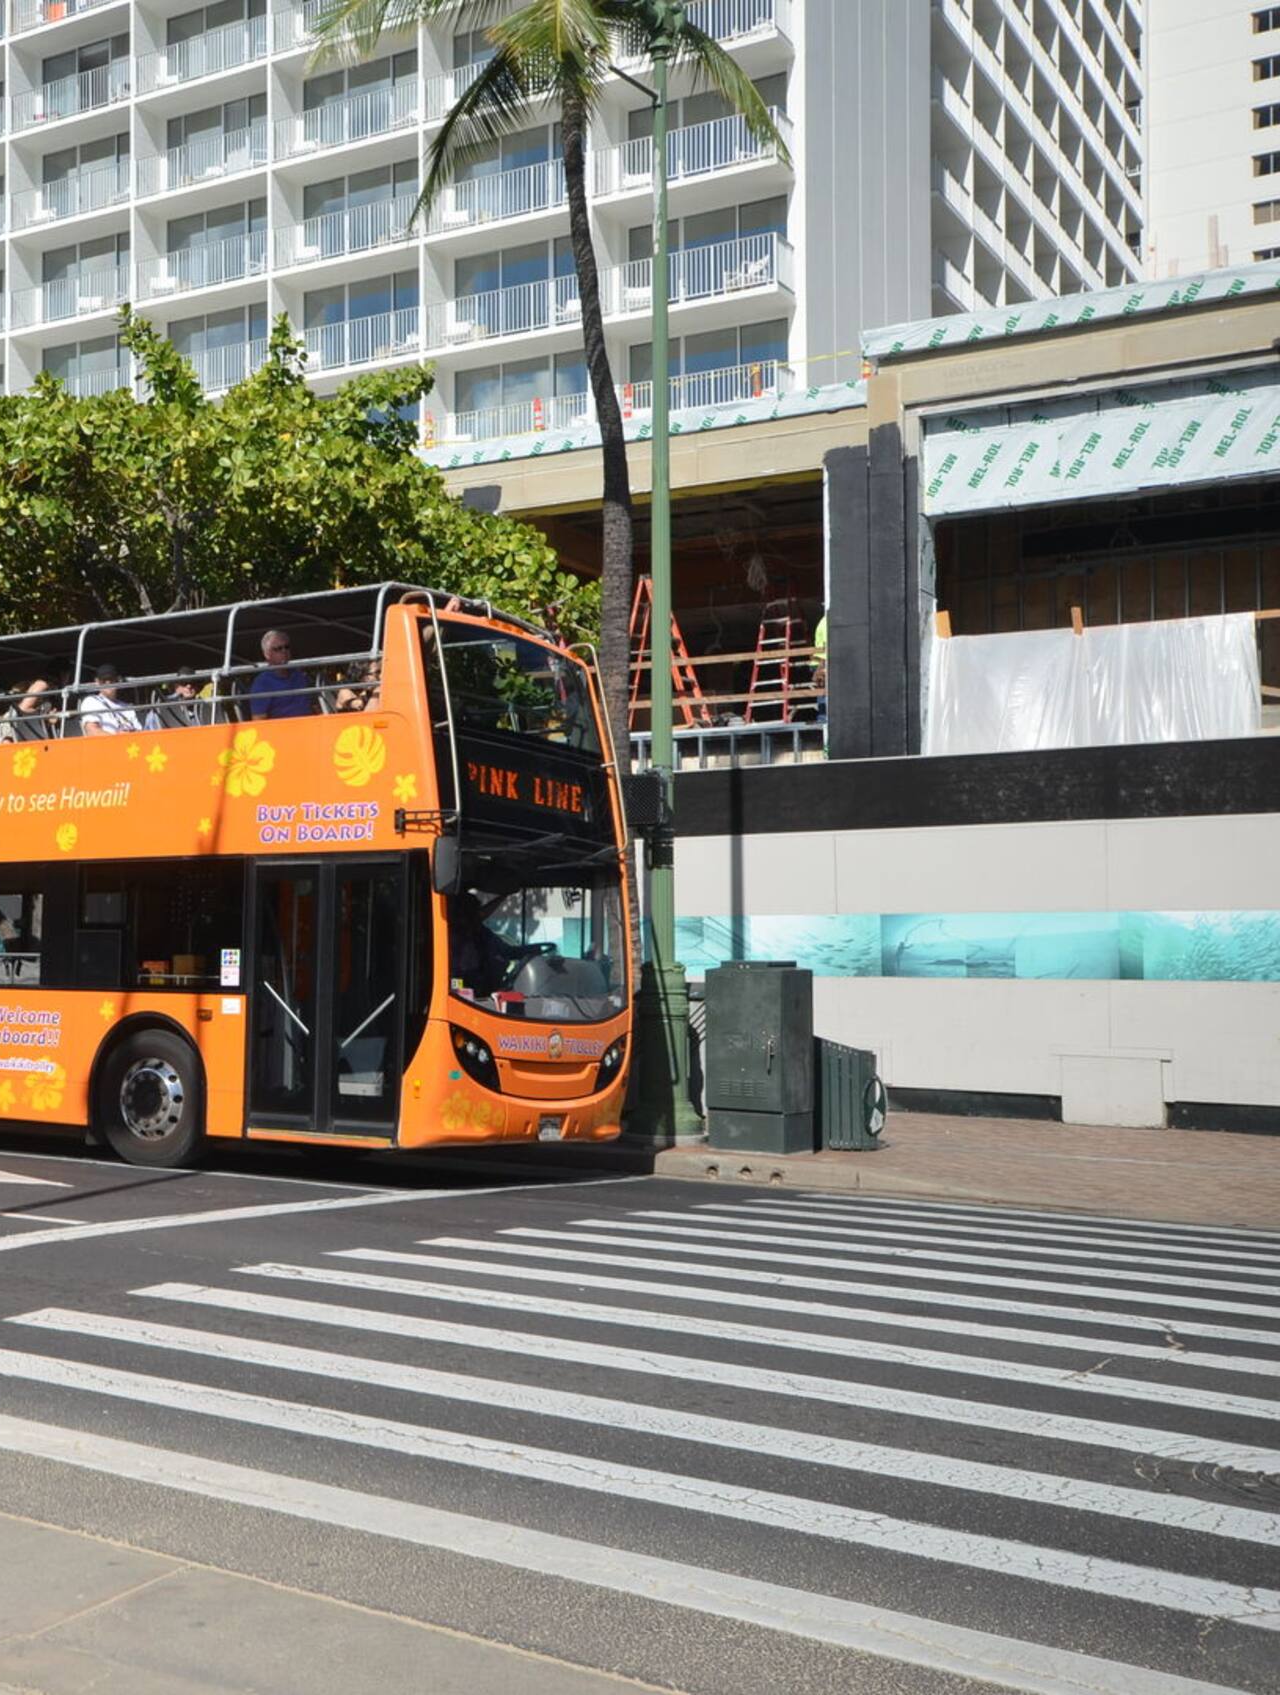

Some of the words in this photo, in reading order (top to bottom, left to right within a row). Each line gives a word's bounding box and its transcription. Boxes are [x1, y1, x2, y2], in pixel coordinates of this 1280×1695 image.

[1111, 420, 1151, 470] MEL-ROL
[1213, 405, 1253, 457] MEL-ROL
[968, 441, 1002, 489] MEL-ROL
[1004, 441, 1040, 488] MEL-ROL
[1065, 431, 1102, 480] MEL-ROL
[7, 793, 25, 814] to
[28, 793, 55, 812] see
[59, 782, 131, 810] Hawaii!
[533, 777, 583, 814] LINE
[497, 1035, 547, 1052] WAIKIKI
